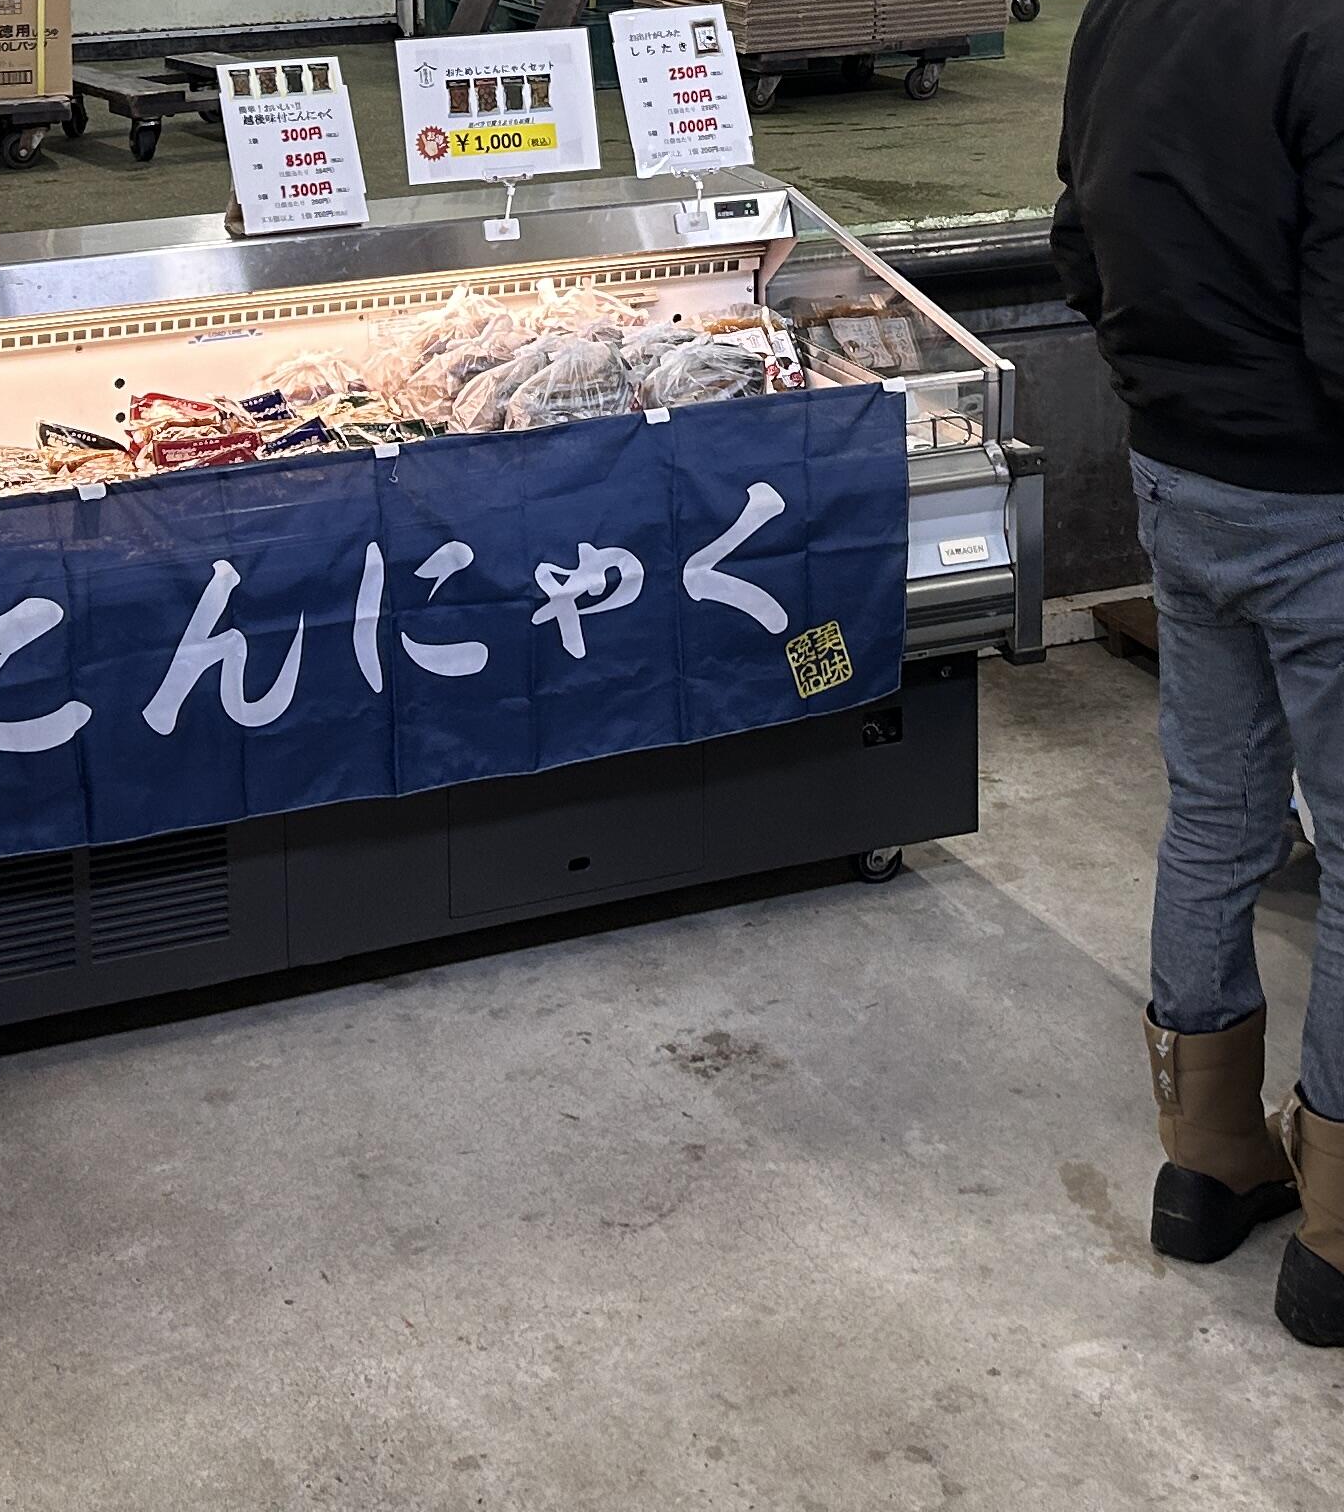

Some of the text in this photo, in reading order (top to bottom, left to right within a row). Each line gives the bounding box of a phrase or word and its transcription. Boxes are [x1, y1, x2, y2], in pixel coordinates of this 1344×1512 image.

[630, 43, 688, 57] しらたき
[445, 60, 554, 78] おためしこんにゃくセット
[668, 65, 708, 80] 250円
[673, 89, 713, 105] 700円
[244, 108, 333, 125] 越後味付こんにゃく
[281, 126, 322, 142] 300円
[669, 117, 718, 135] 1,000円
[527, 136, 552, 147] (税込)
[285, 151, 327, 167] 850円
[280, 181, 332, 198] 1,300円
[944, 545, 984, 557] YAMAGEN
